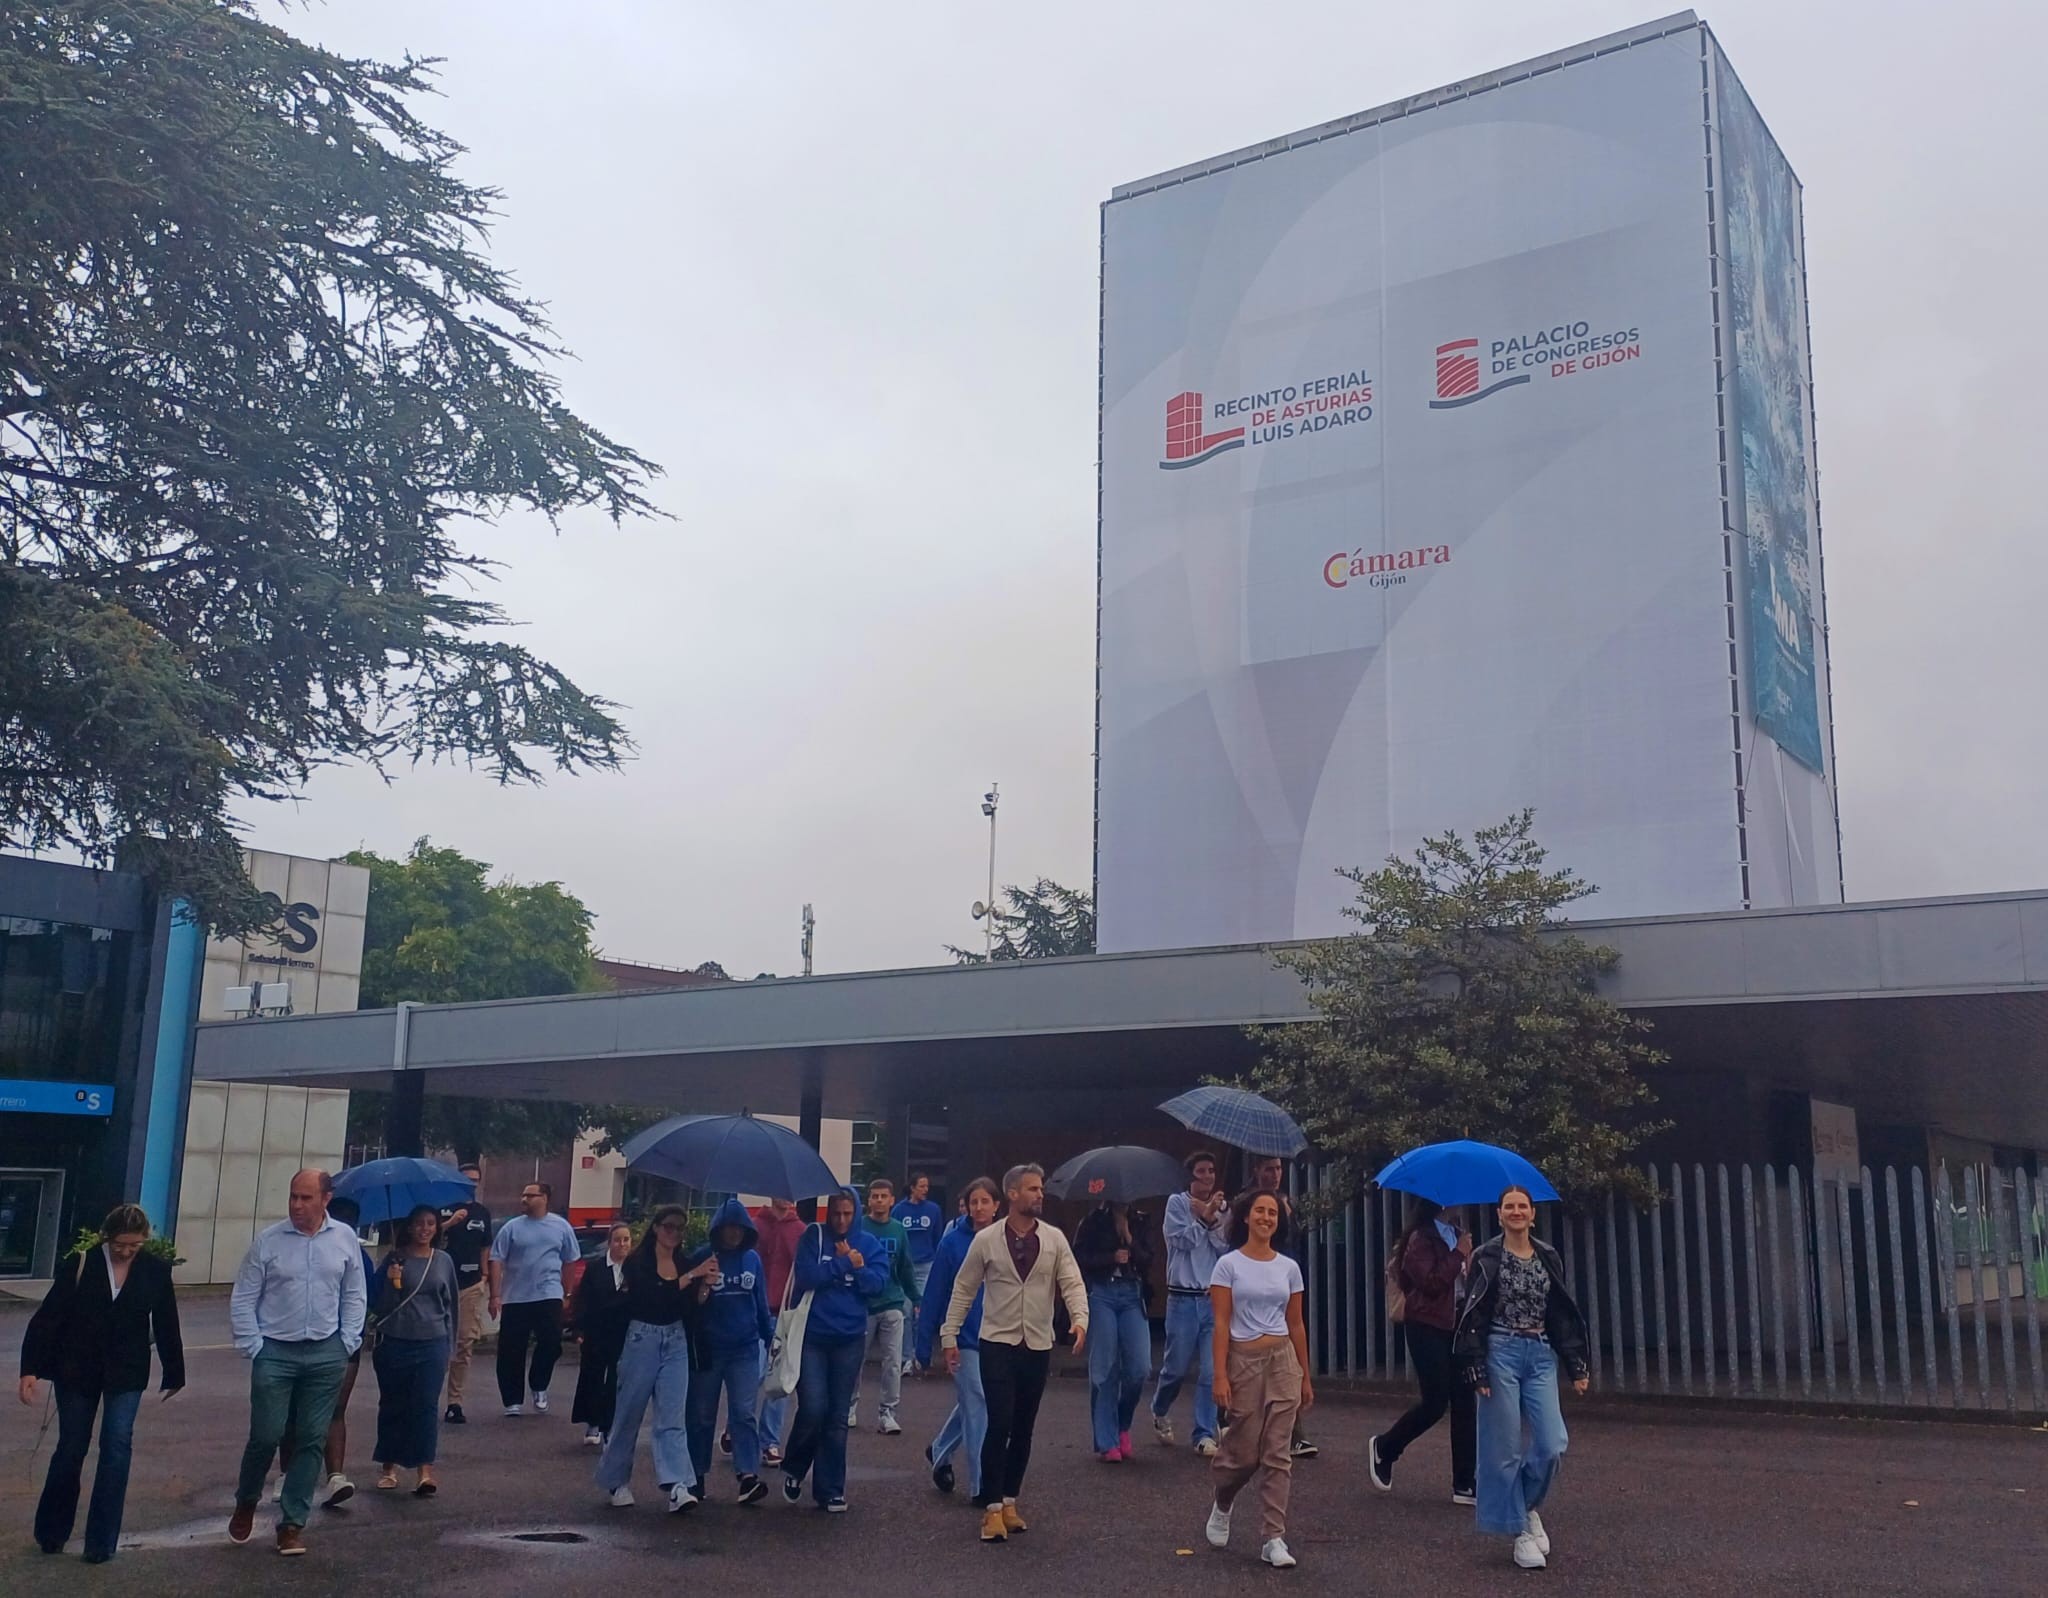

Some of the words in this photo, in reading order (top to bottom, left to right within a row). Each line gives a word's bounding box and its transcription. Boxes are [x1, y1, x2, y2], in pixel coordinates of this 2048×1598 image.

[1491, 320, 1590, 358] PALACIO
[1491, 357, 1517, 374] DE
[1521, 327, 1640, 367] CONGRESOS
[1551, 361, 1577, 378] DE
[1581, 343, 1641, 371] GIJÓN
[1214, 385, 1297, 418] RECINTO
[1302, 369, 1373, 398] FERIAL
[1252, 408, 1276, 426] DE
[1280, 387, 1373, 422] ASTURIAS
[1252, 422, 1294, 445] LUIS
[1299, 405, 1373, 437] ADARO
[1323, 544, 1452, 589] Cámara
[1369, 572, 1407, 590] Gijón
